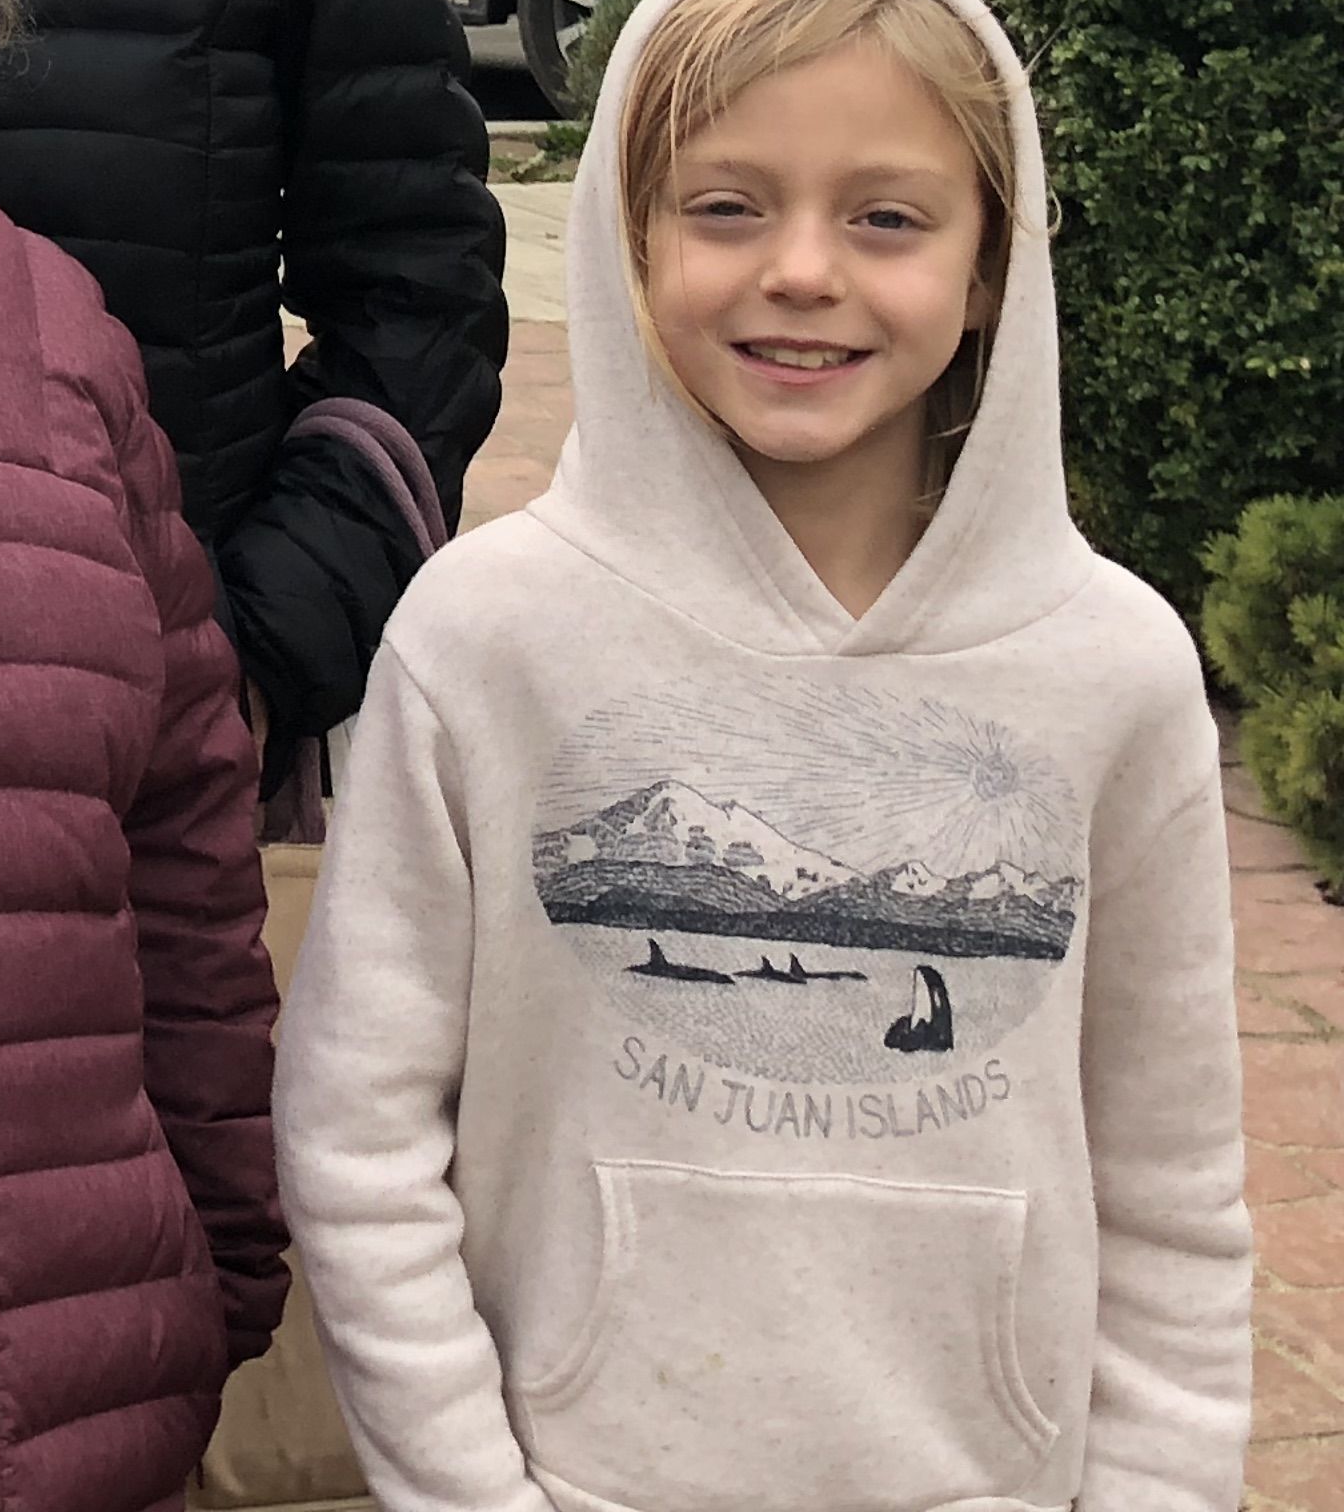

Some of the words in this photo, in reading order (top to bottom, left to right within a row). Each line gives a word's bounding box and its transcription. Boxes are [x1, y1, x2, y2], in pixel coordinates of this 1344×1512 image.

[613, 1036, 705, 1112] SAN
[713, 1079, 832, 1139] JUAN
[846, 1059, 1012, 1140] ISLANDS
